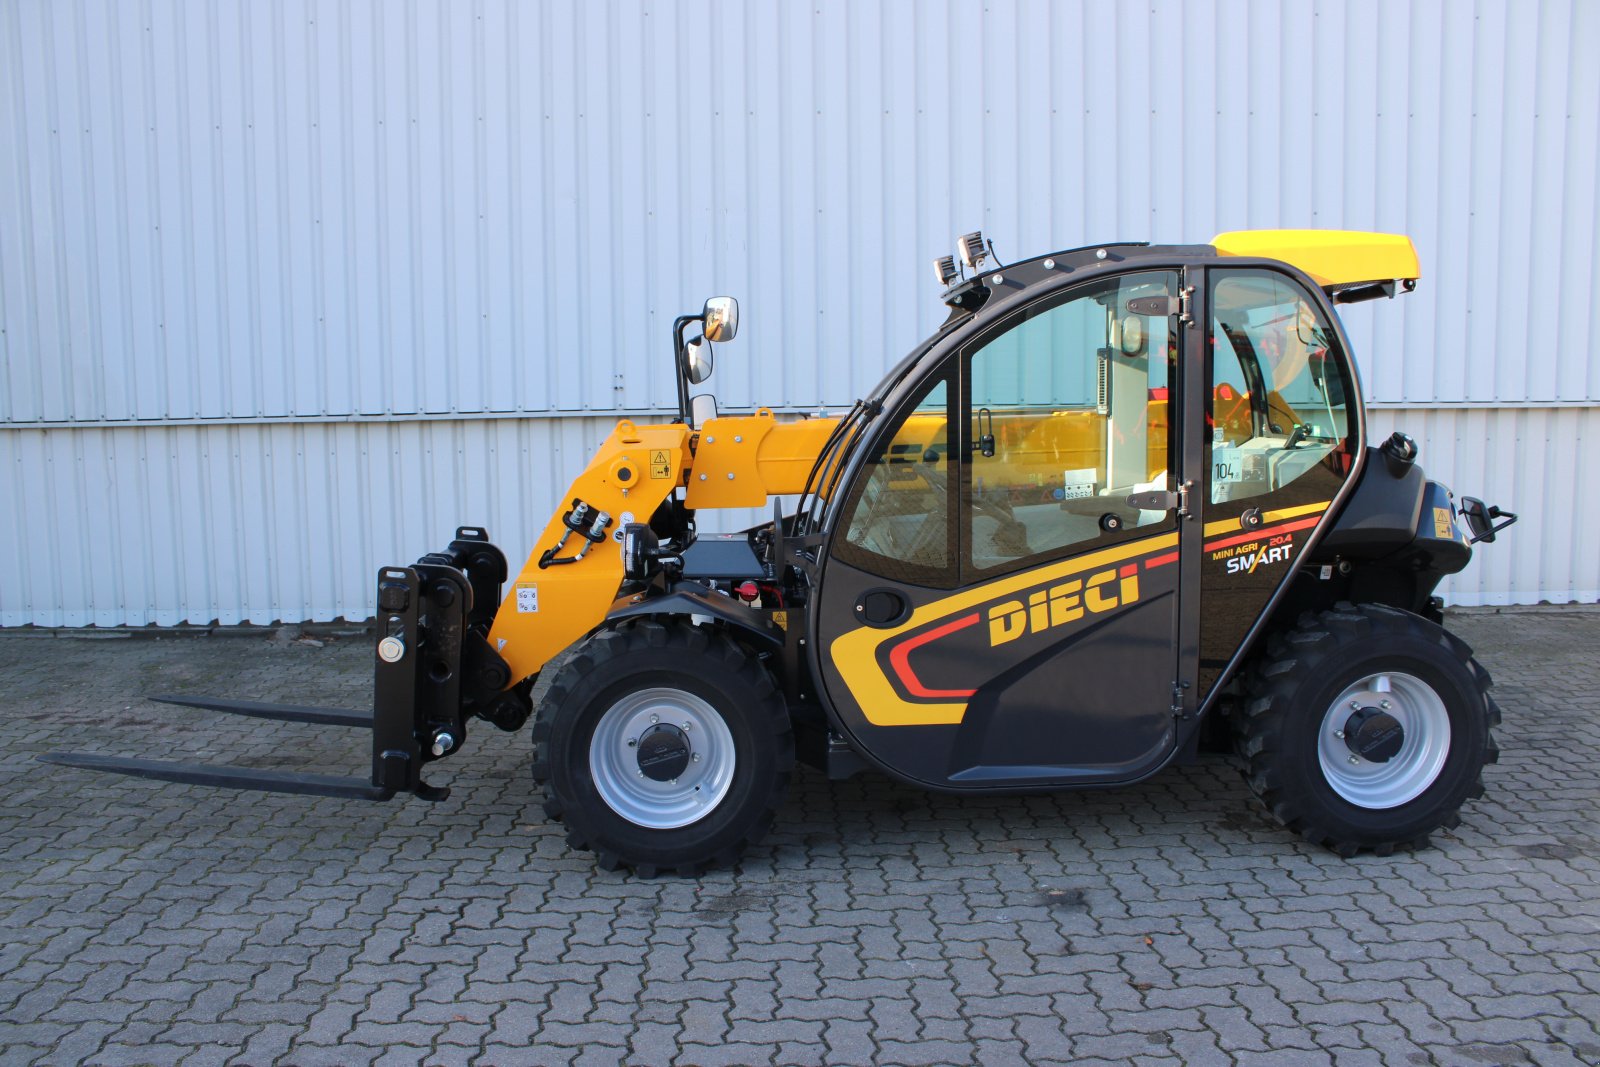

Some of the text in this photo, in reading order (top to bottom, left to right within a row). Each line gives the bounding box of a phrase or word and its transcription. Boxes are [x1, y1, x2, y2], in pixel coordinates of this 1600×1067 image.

[1215, 463, 1234, 479] 104
[1269, 534, 1293, 546] 20.4
[1212, 542, 1258, 560] MINI AGRI
[1226, 544, 1293, 574] SMART
